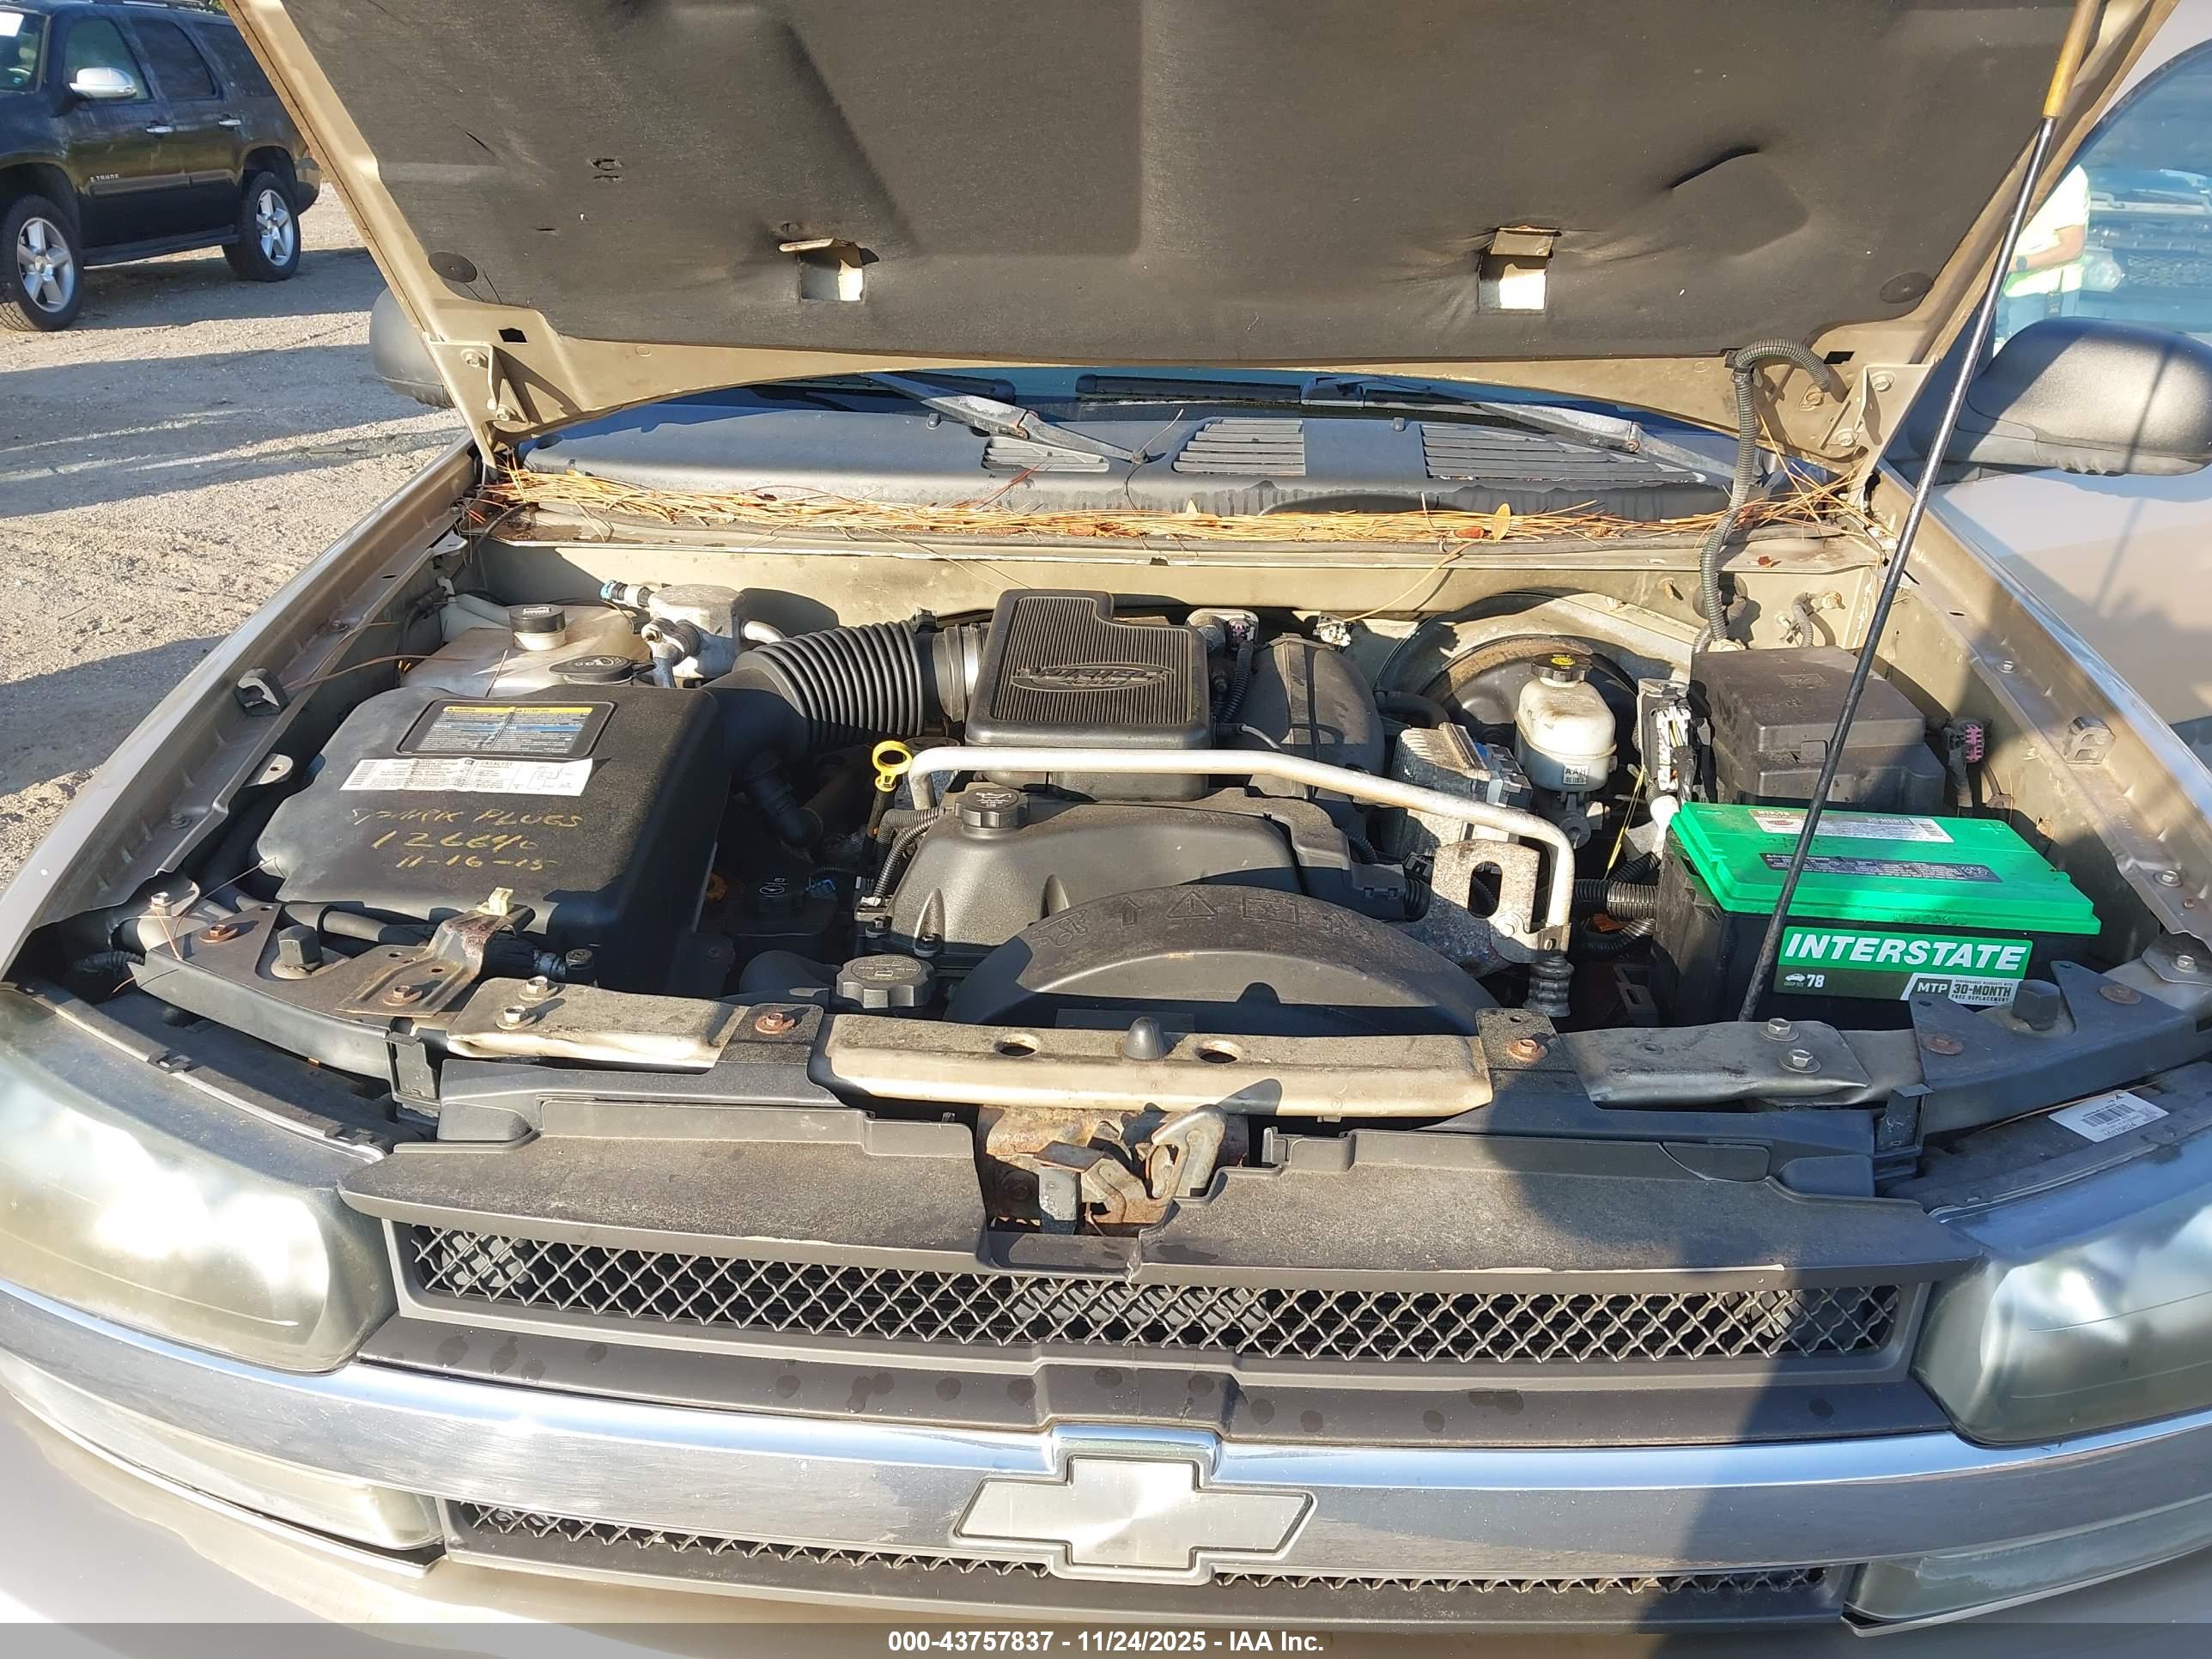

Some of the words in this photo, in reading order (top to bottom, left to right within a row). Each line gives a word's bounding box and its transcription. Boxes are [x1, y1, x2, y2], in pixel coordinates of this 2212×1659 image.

[1785, 933, 2027, 970] INTERSTATE
[1806, 974, 1826, 988] 78
[1917, 981, 1948, 994] MTP
[1953, 983, 2012, 997] 30-MONTH
